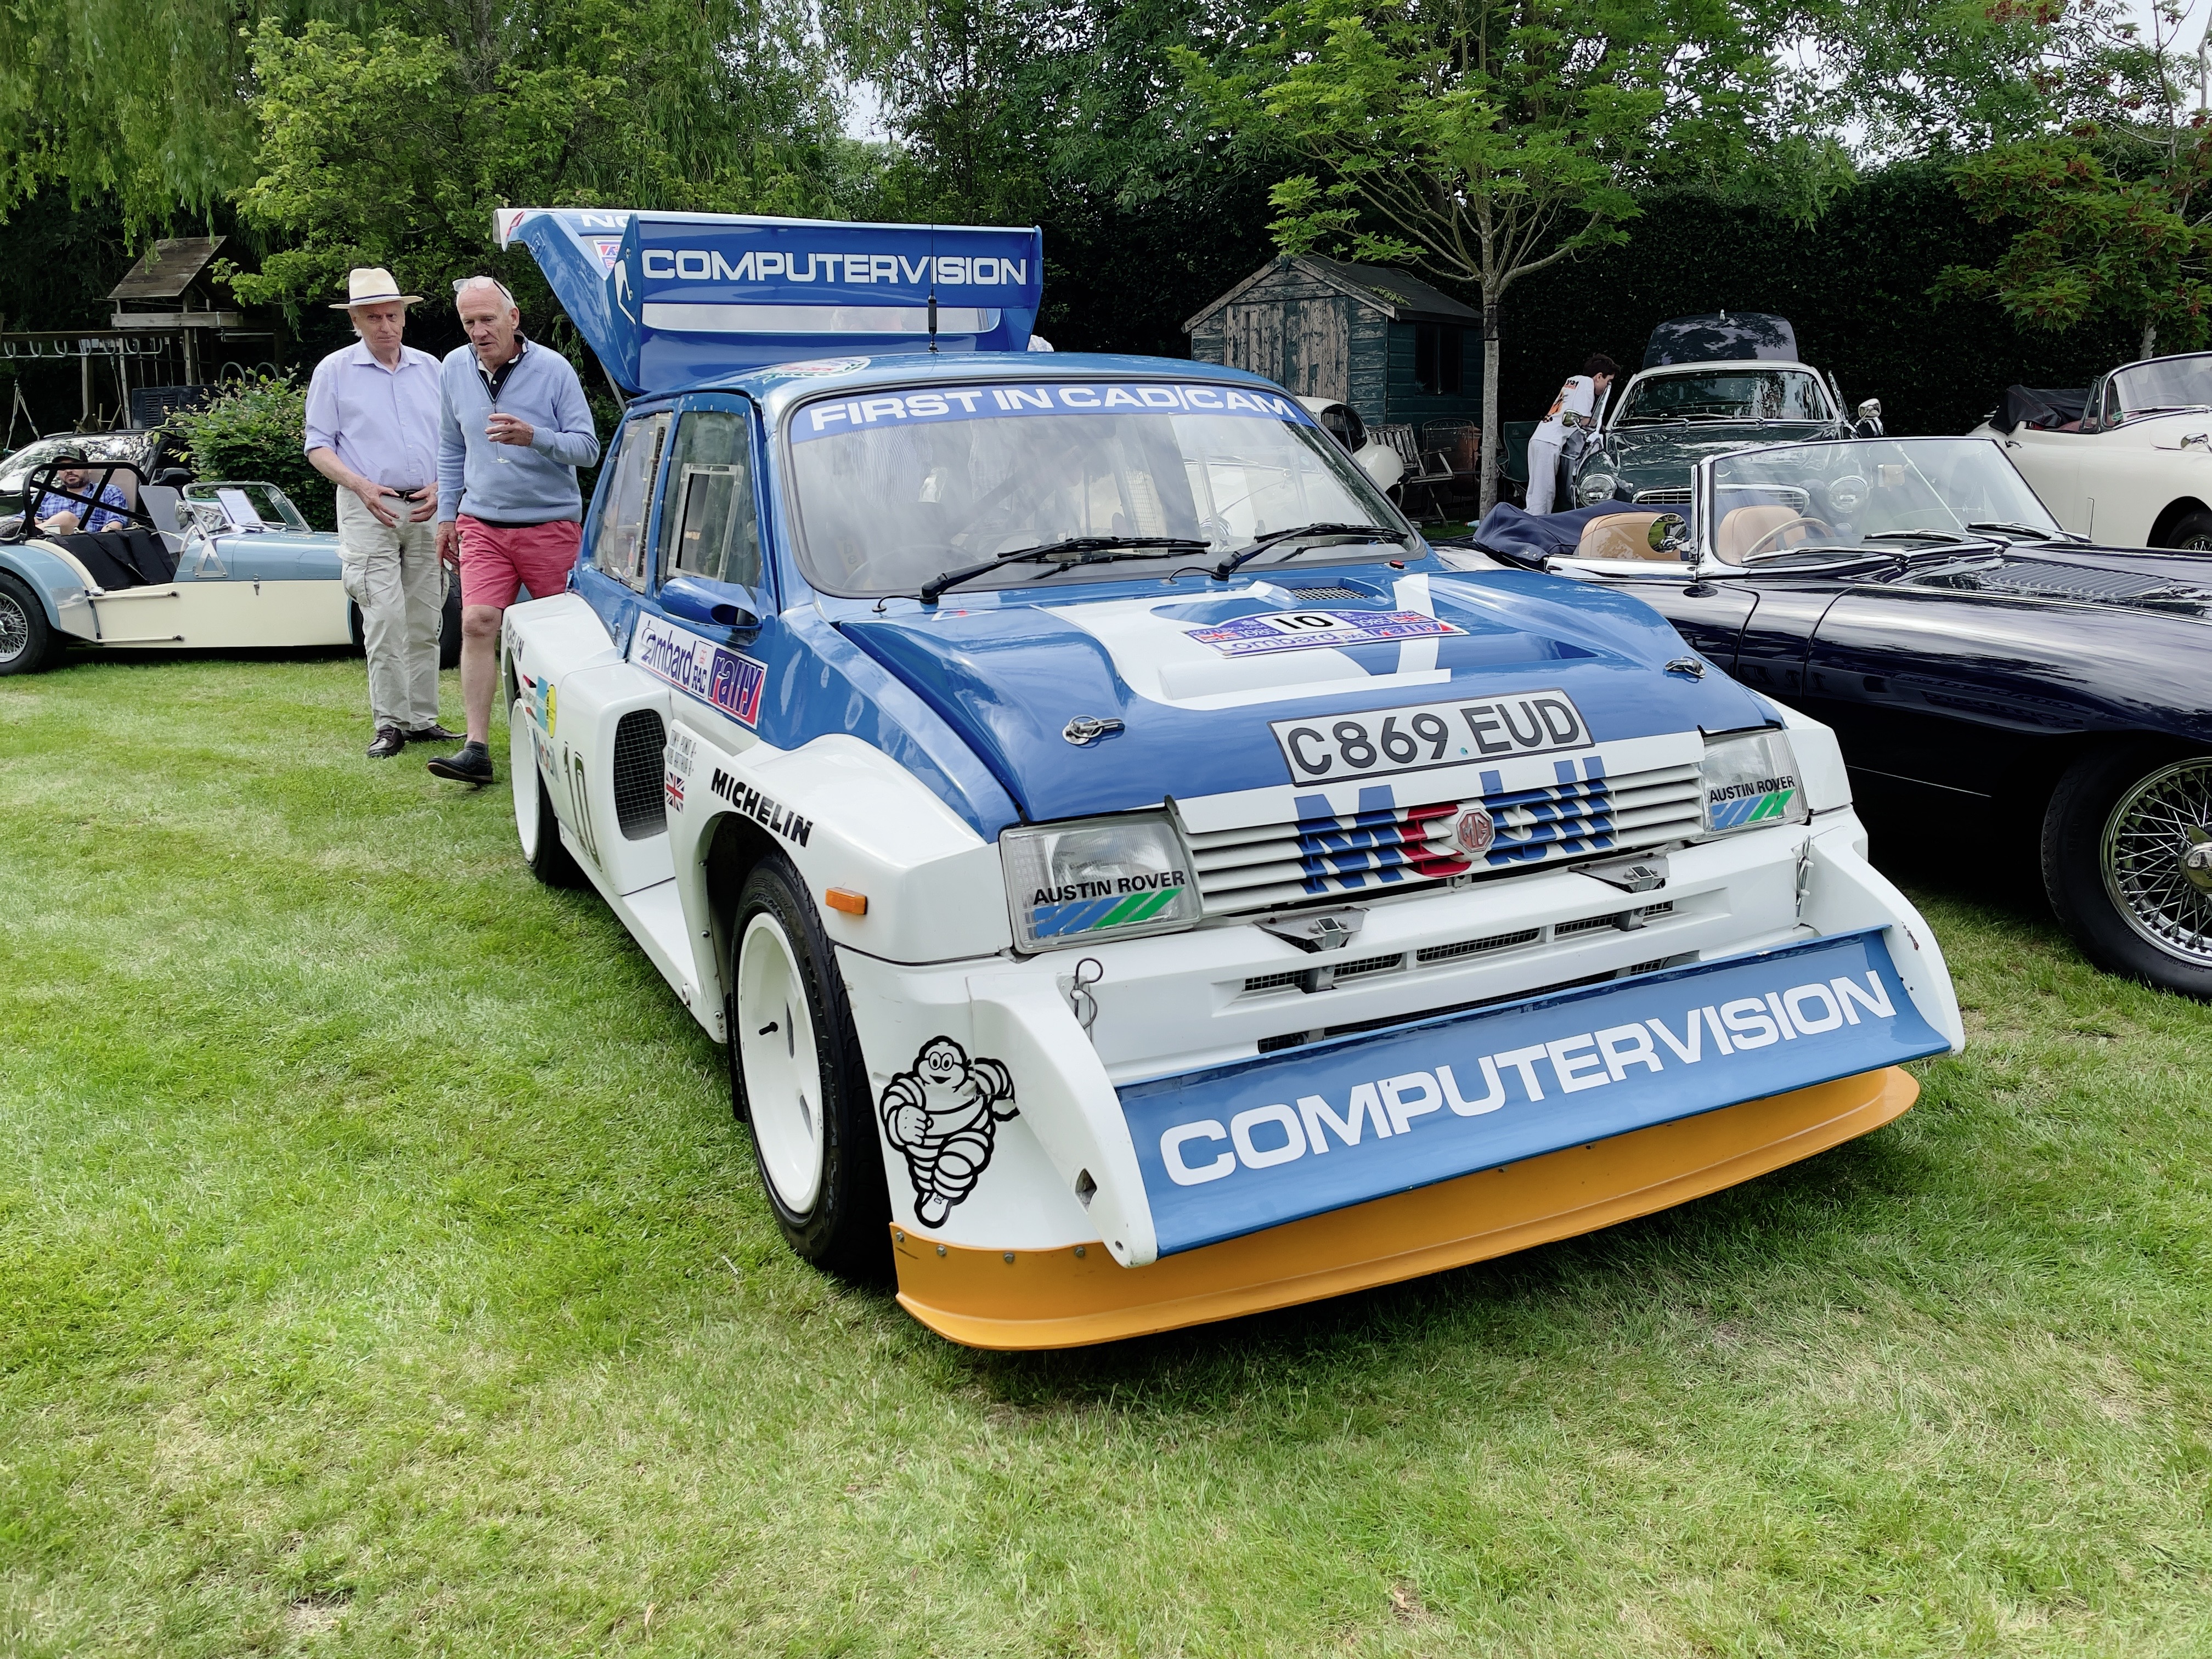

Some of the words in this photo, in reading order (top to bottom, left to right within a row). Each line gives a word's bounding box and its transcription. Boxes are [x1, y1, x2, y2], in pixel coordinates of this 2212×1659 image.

[641, 249, 1026, 285] COMPUTERVISION
[810, 390, 984, 431] FIRST
[992, 388, 1053, 410] IN
[1238, 629, 1279, 638] 1985
[1272, 615, 1333, 630] 10
[1353, 618, 1393, 627] 1985
[1218, 631, 1338, 653] Lombard
[641, 620, 697, 686] Lombard
[691, 665, 708, 695] RAC
[709, 656, 765, 718] rally
[1288, 713, 1448, 775] C869
[1460, 699, 1579, 754] EUD
[1710, 782, 1755, 803] AUSTIN
[1757, 775, 1796, 793] ROVER
[711, 768, 813, 848] MICHELIN
[1462, 815, 1488, 846] MG
[1034, 881, 1112, 905] AUSTIN
[1118, 871, 1186, 893] ROVER
[1160, 970, 1897, 1187] COMPUTERVISION
